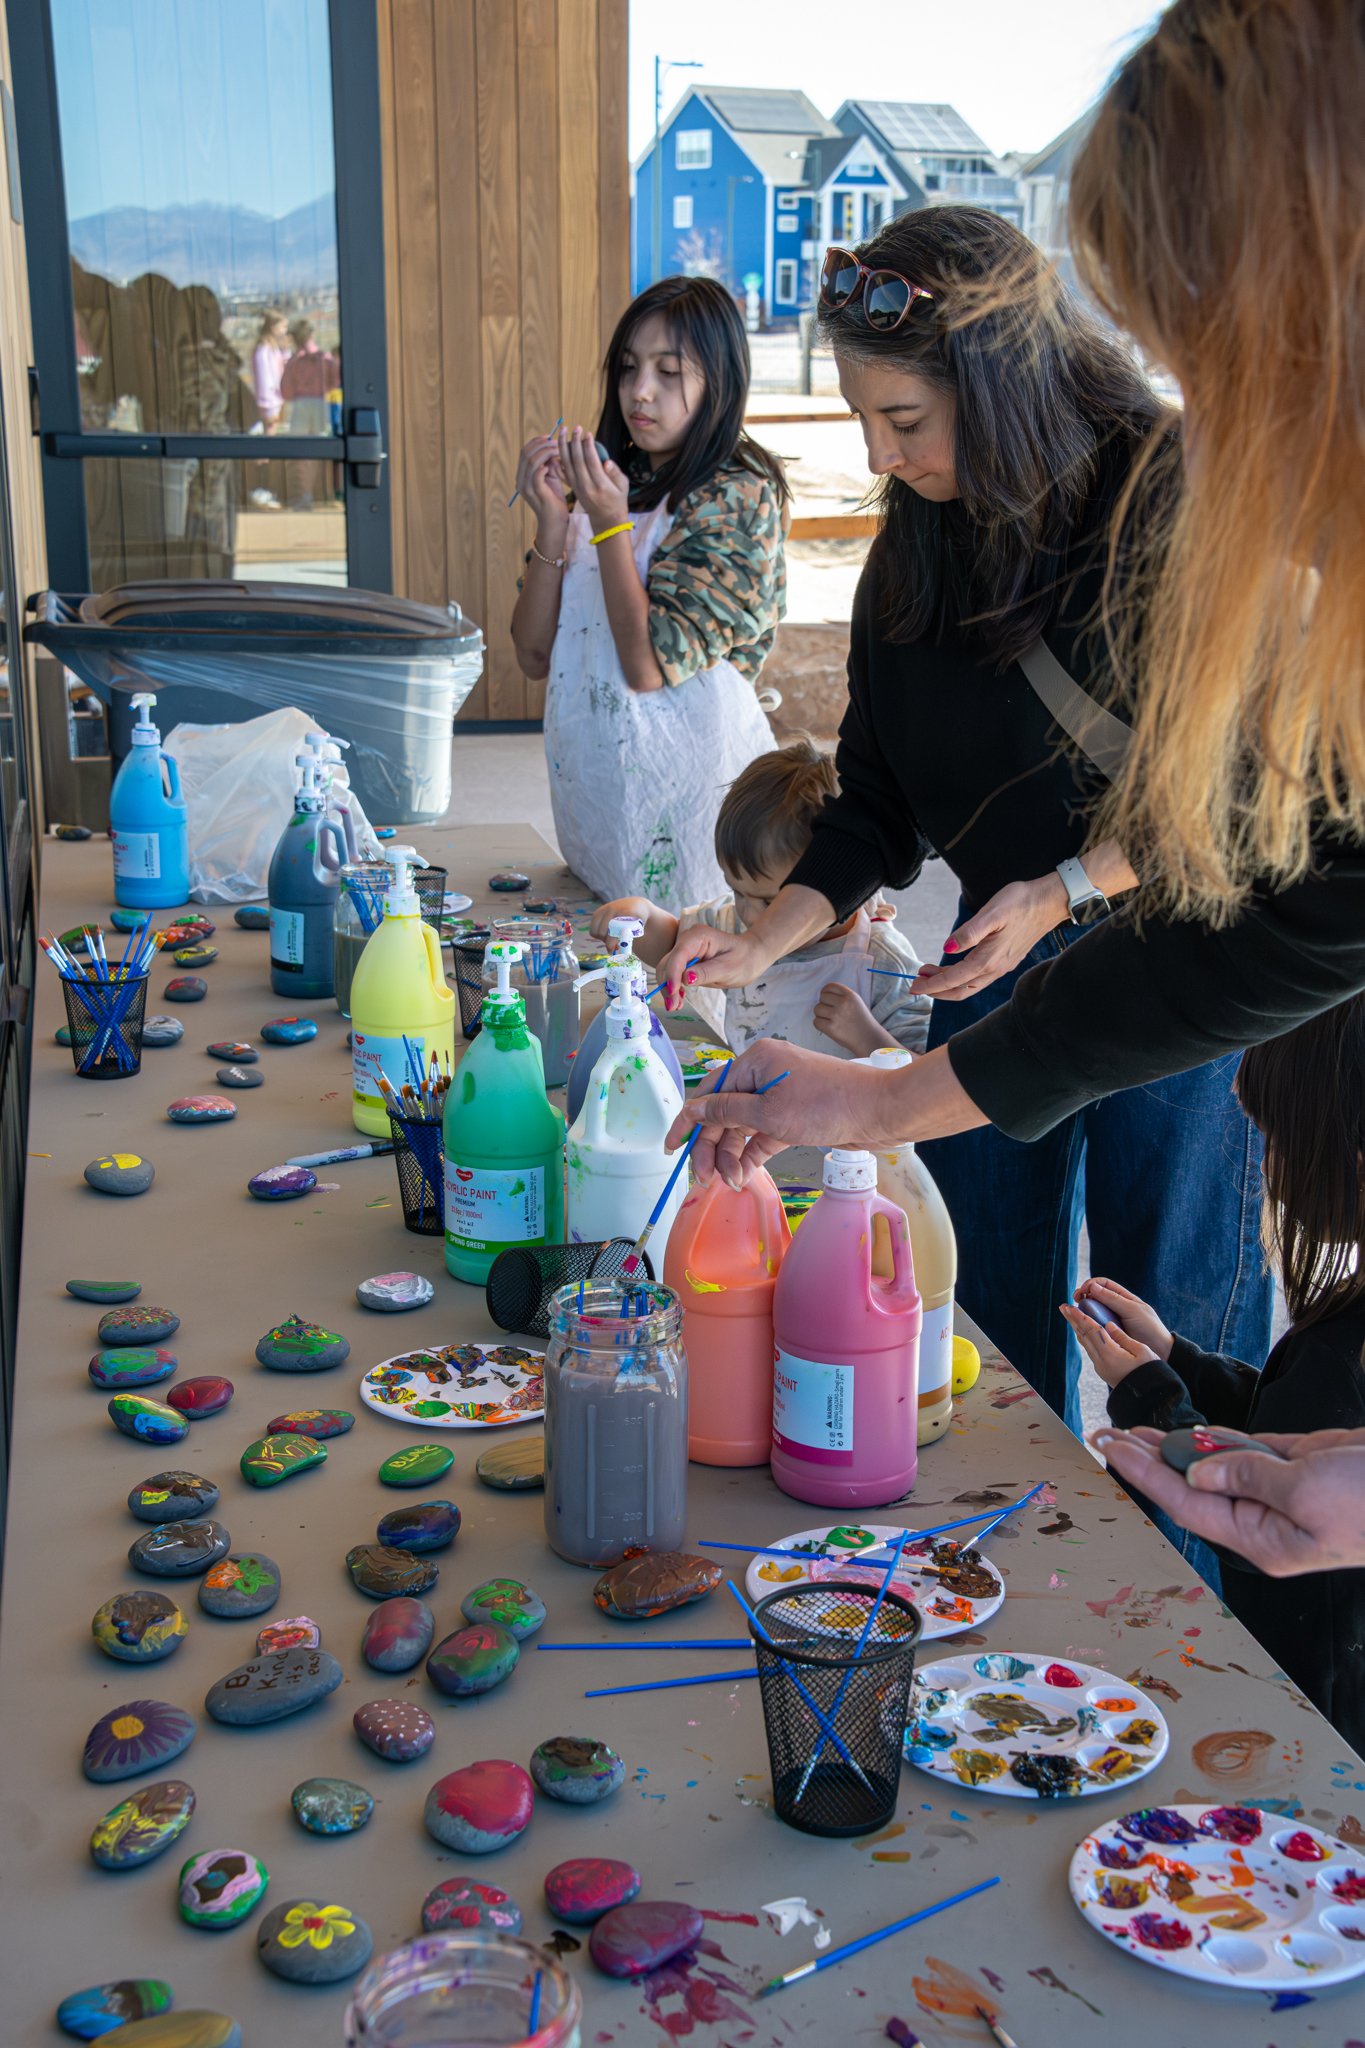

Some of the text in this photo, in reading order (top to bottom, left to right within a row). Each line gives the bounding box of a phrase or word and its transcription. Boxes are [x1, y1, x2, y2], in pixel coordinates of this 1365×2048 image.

[363, 1051, 382, 1062] PAINT
[455, 1197, 476, 1208] PREMIUM
[470, 1188, 497, 1201] PAINT
[450, 1235, 486, 1251] SPRING GREEN
[777, 1371, 798, 1393] PAINT
[224, 1664, 261, 1690] Be
[256, 1651, 290, 1691] Kind
[285, 1664, 304, 1684] it's
